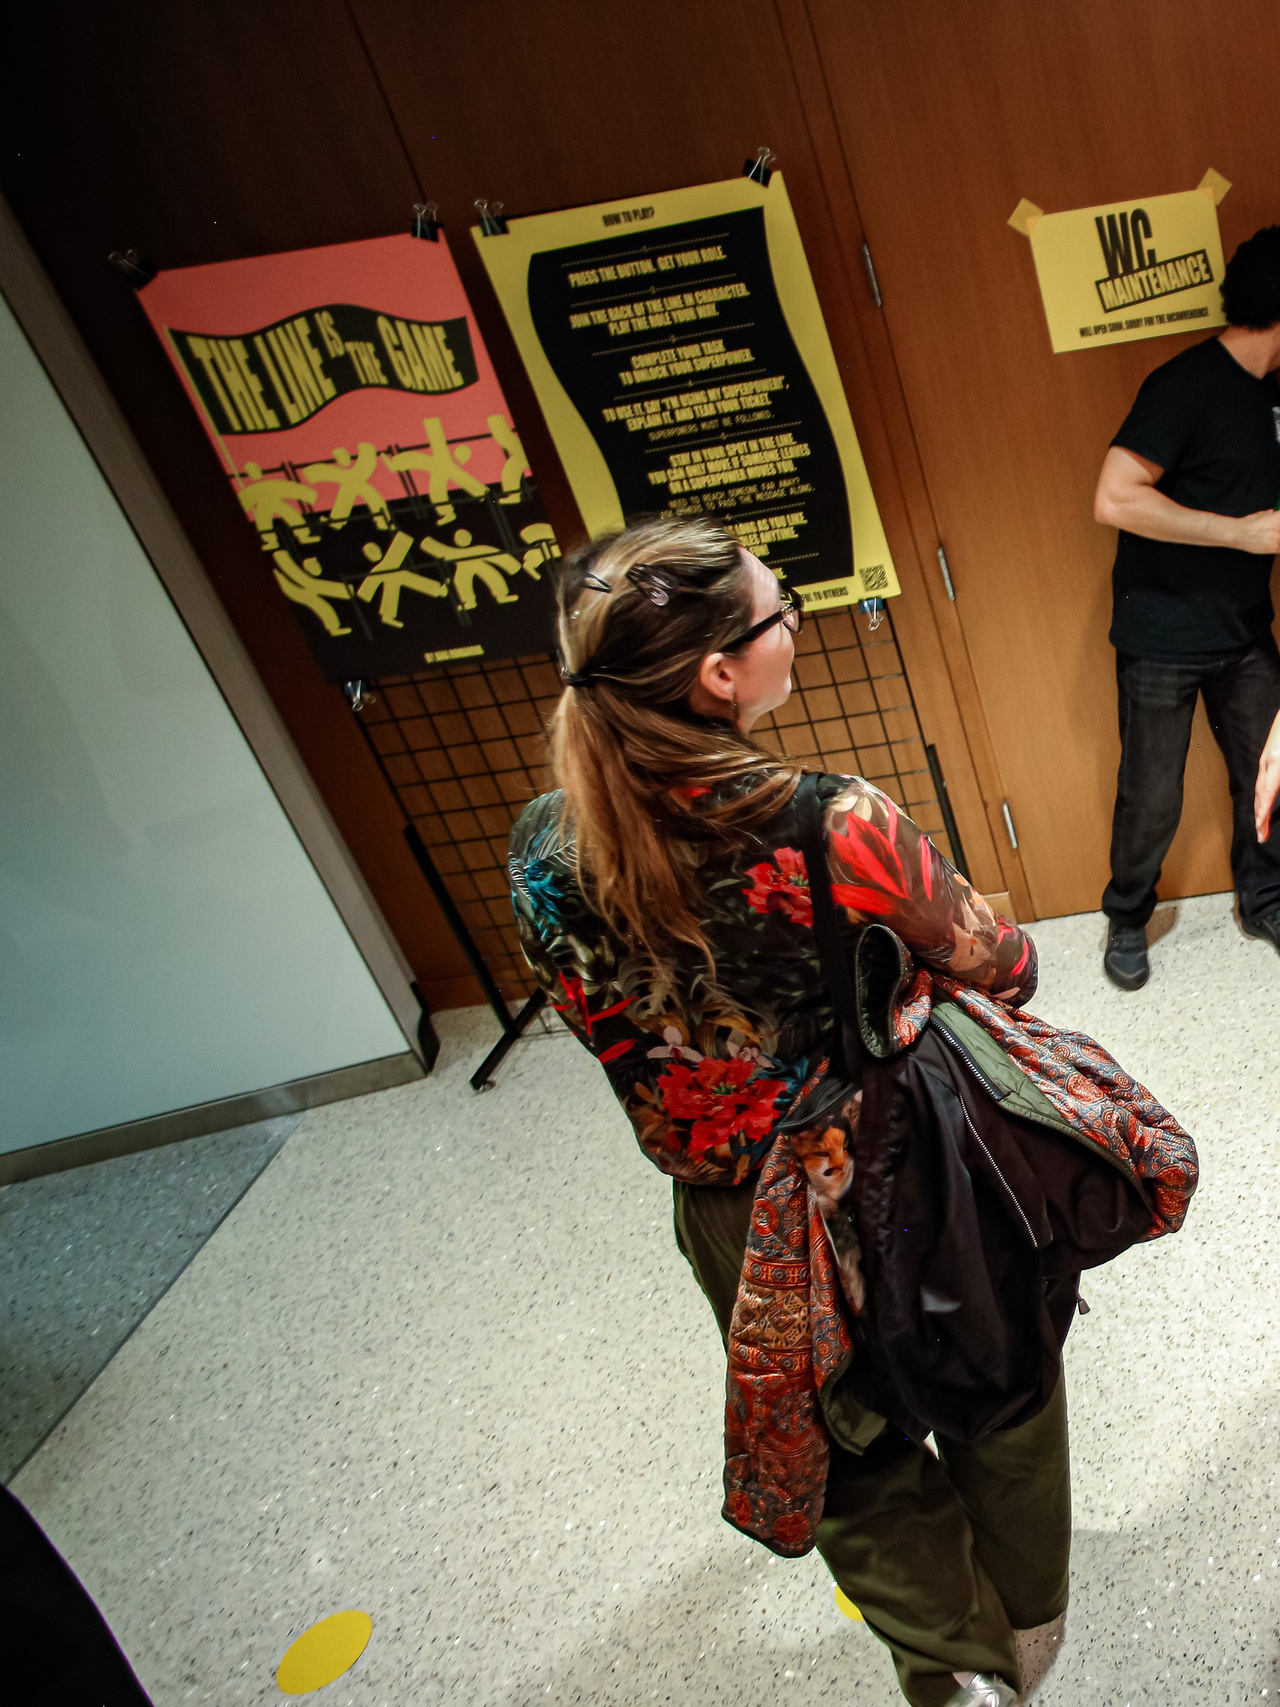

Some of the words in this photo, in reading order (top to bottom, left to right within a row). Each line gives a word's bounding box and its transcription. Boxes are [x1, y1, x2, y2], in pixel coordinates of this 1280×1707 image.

[603, 213, 621, 226] HOW
[622, 210, 632, 223] TO
[633, 207, 654, 221] PLAY?
[1095, 208, 1156, 276] WC
[569, 270, 599, 288] PRESS
[599, 267, 617, 282] THE
[617, 260, 656, 278] BUTTON.
[657, 256, 674, 271] GET
[675, 251, 701, 267] YOUR
[701, 246, 726, 262] ROLE.
[1099, 254, 1210, 309] MAINTENANCE
[570, 313, 591, 329] JOIN
[590, 310, 608, 325] THE
[608, 305, 633, 322] BACK
[633, 303, 646, 316] OF
[646, 300, 664, 314] THE
[664, 295, 683, 311] LINE
[684, 293, 694, 306] IN
[695, 283, 750, 303] CHARACTER.
[608, 320, 630, 336] PLAY
[631, 317, 649, 332] THE
[649, 312, 672, 327] ROLE
[671, 308, 697, 324] YOUR
[696, 303, 719, 319] WAY.
[1094, 324, 1107, 334] OPEN
[1125, 318, 1143, 329] SORRY
[1145, 316, 1155, 326] FOR
[1156, 314, 1166, 324] THE
[187, 336, 281, 431] THE
[253, 317, 337, 425] LINE
[314, 311, 345, 358] IS
[345, 341, 388, 385] THE
[377, 316, 464, 391] GAME
[619, 371, 633, 386] TO
[633, 365, 669, 383] UNLOCK
[669, 361, 694, 376] YOUR
[693, 349, 755, 370] SUPERPOWER.
[631, 350, 677, 369] COMPLETE
[677, 344, 701, 360] YOUR
[702, 339, 725, 354] TASK
[603, 408, 616, 422] TO
[616, 405, 634, 419] USE
[644, 400, 661, 414] SAY
[679, 390, 707, 407] USING
[707, 388, 721, 402] MY
[626, 413, 662, 432] EXPLAIN
[675, 407, 694, 421] AND
[694, 403, 716, 418] TEAR
[716, 399, 740, 414] YOUR
[740, 393, 771, 410] TICKET.
[649, 424, 698, 441] SUPERPOWERS
[701, 420, 719, 431] MUST
[722, 417, 733, 426] BE
[648, 471, 667, 485] YOU
[667, 468, 685, 481] CAN
[685, 463, 706, 478] ONLY
[707, 459, 731, 472] MOVE
[731, 457, 740, 469] IF
[740, 450, 781, 467] SOMEONE
[780, 443, 810, 459] LEAVES
[670, 453, 691, 467] STAY
[691, 451, 703, 463] IN
[702, 446, 726, 461] YOUR
[726, 442, 748, 456] SPOT
[748, 440, 759, 452] IN
[759, 437, 775, 450] THE
[776, 433, 797, 447] LINE.
[669, 481, 684, 494] OR
[683, 480, 690, 491] A
[690, 469, 747, 489] SUPERPOWER
[747, 463, 776, 479] MOVES
[777, 460, 797, 473] YOU.
[669, 499, 687, 507] NEED
[702, 492, 725, 502] REACH
[728, 485, 758, 497] SOMEONE
[761, 482, 775, 491] FAR
[779, 477, 800, 488] AWAY?
[706, 502, 715, 510] TO
[718, 499, 736, 508] PASS
[756, 489, 786, 500] MESSAGE
[735, 522, 757, 535] LONG
[757, 519, 769, 531] AS
[769, 516, 786, 528] YOU
[760, 527, 798, 543] ANYTIME.
